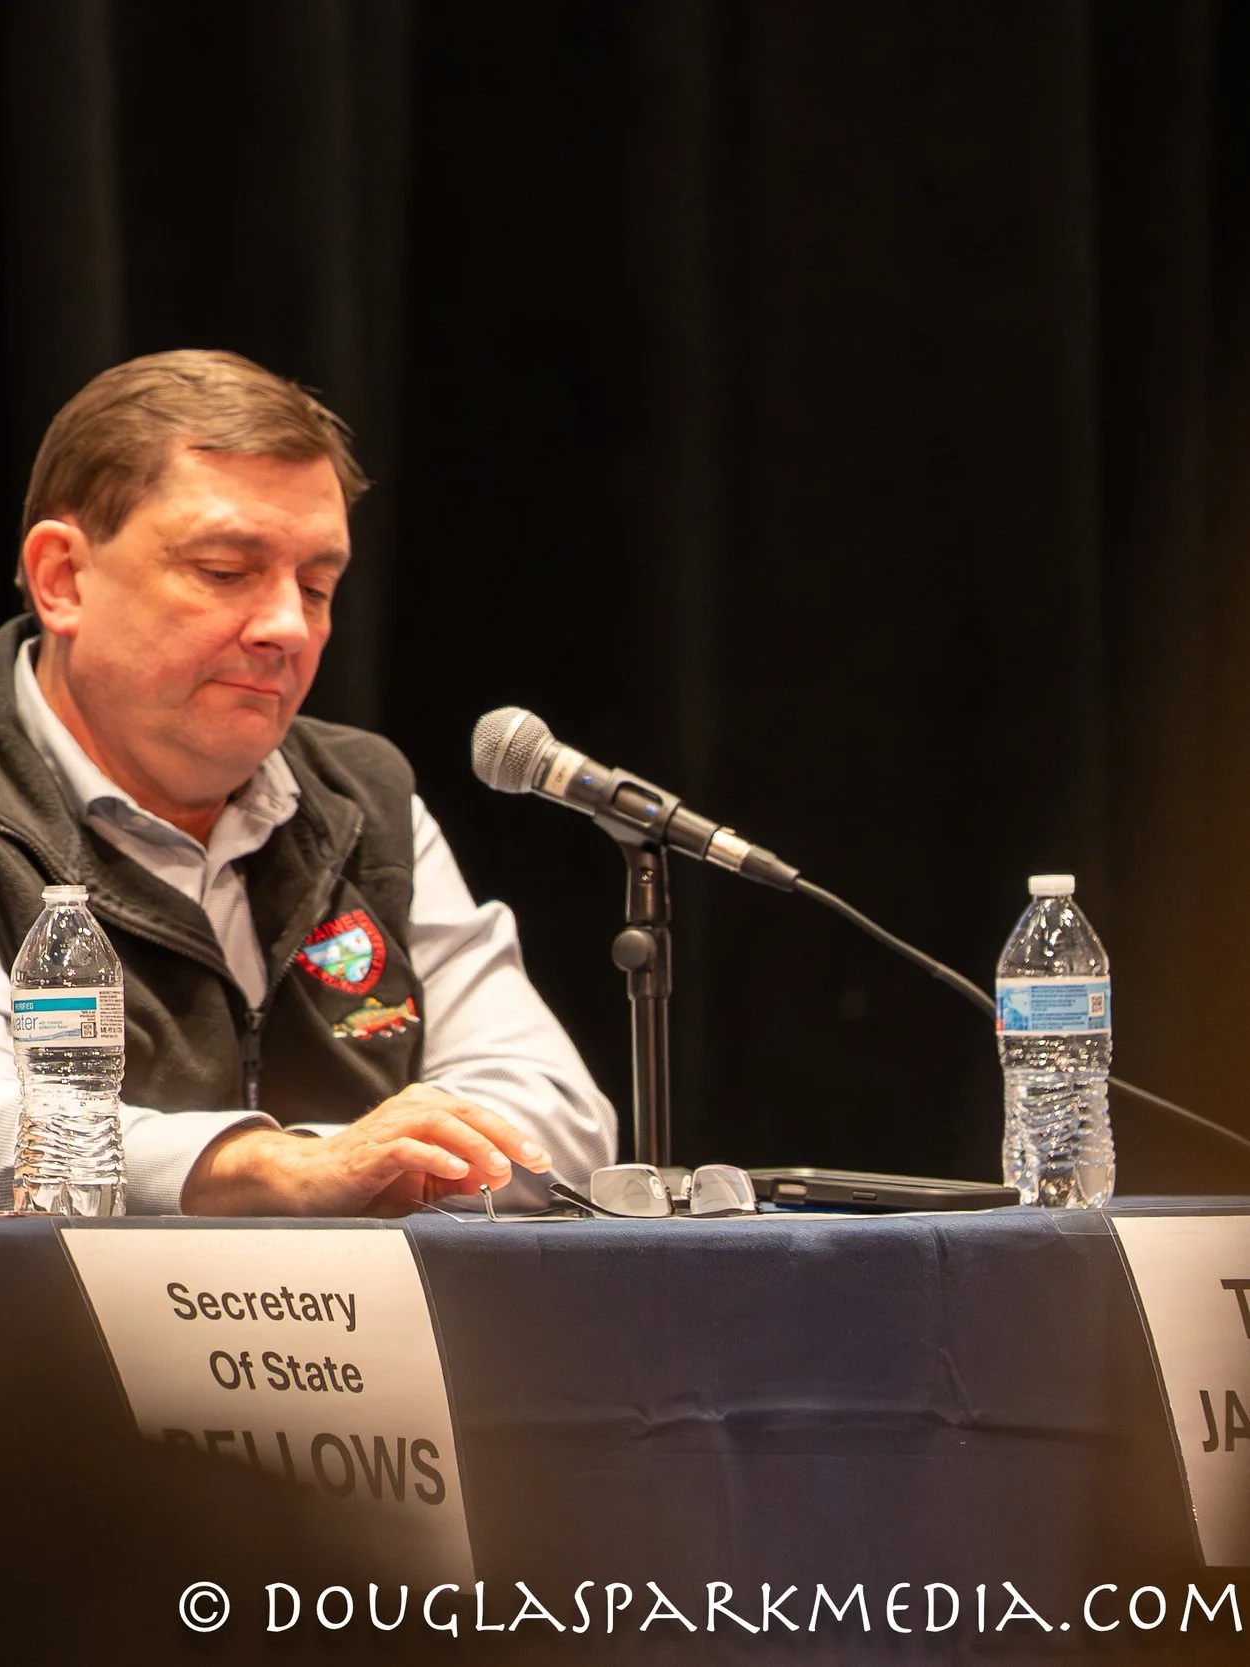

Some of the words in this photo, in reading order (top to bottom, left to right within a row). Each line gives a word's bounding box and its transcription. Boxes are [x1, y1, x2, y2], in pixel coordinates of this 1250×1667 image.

[14, 1014, 38, 1031] ater
[166, 1282, 357, 1332] Secretary
[209, 1350, 257, 1390] Of
[261, 1351, 364, 1393] State
